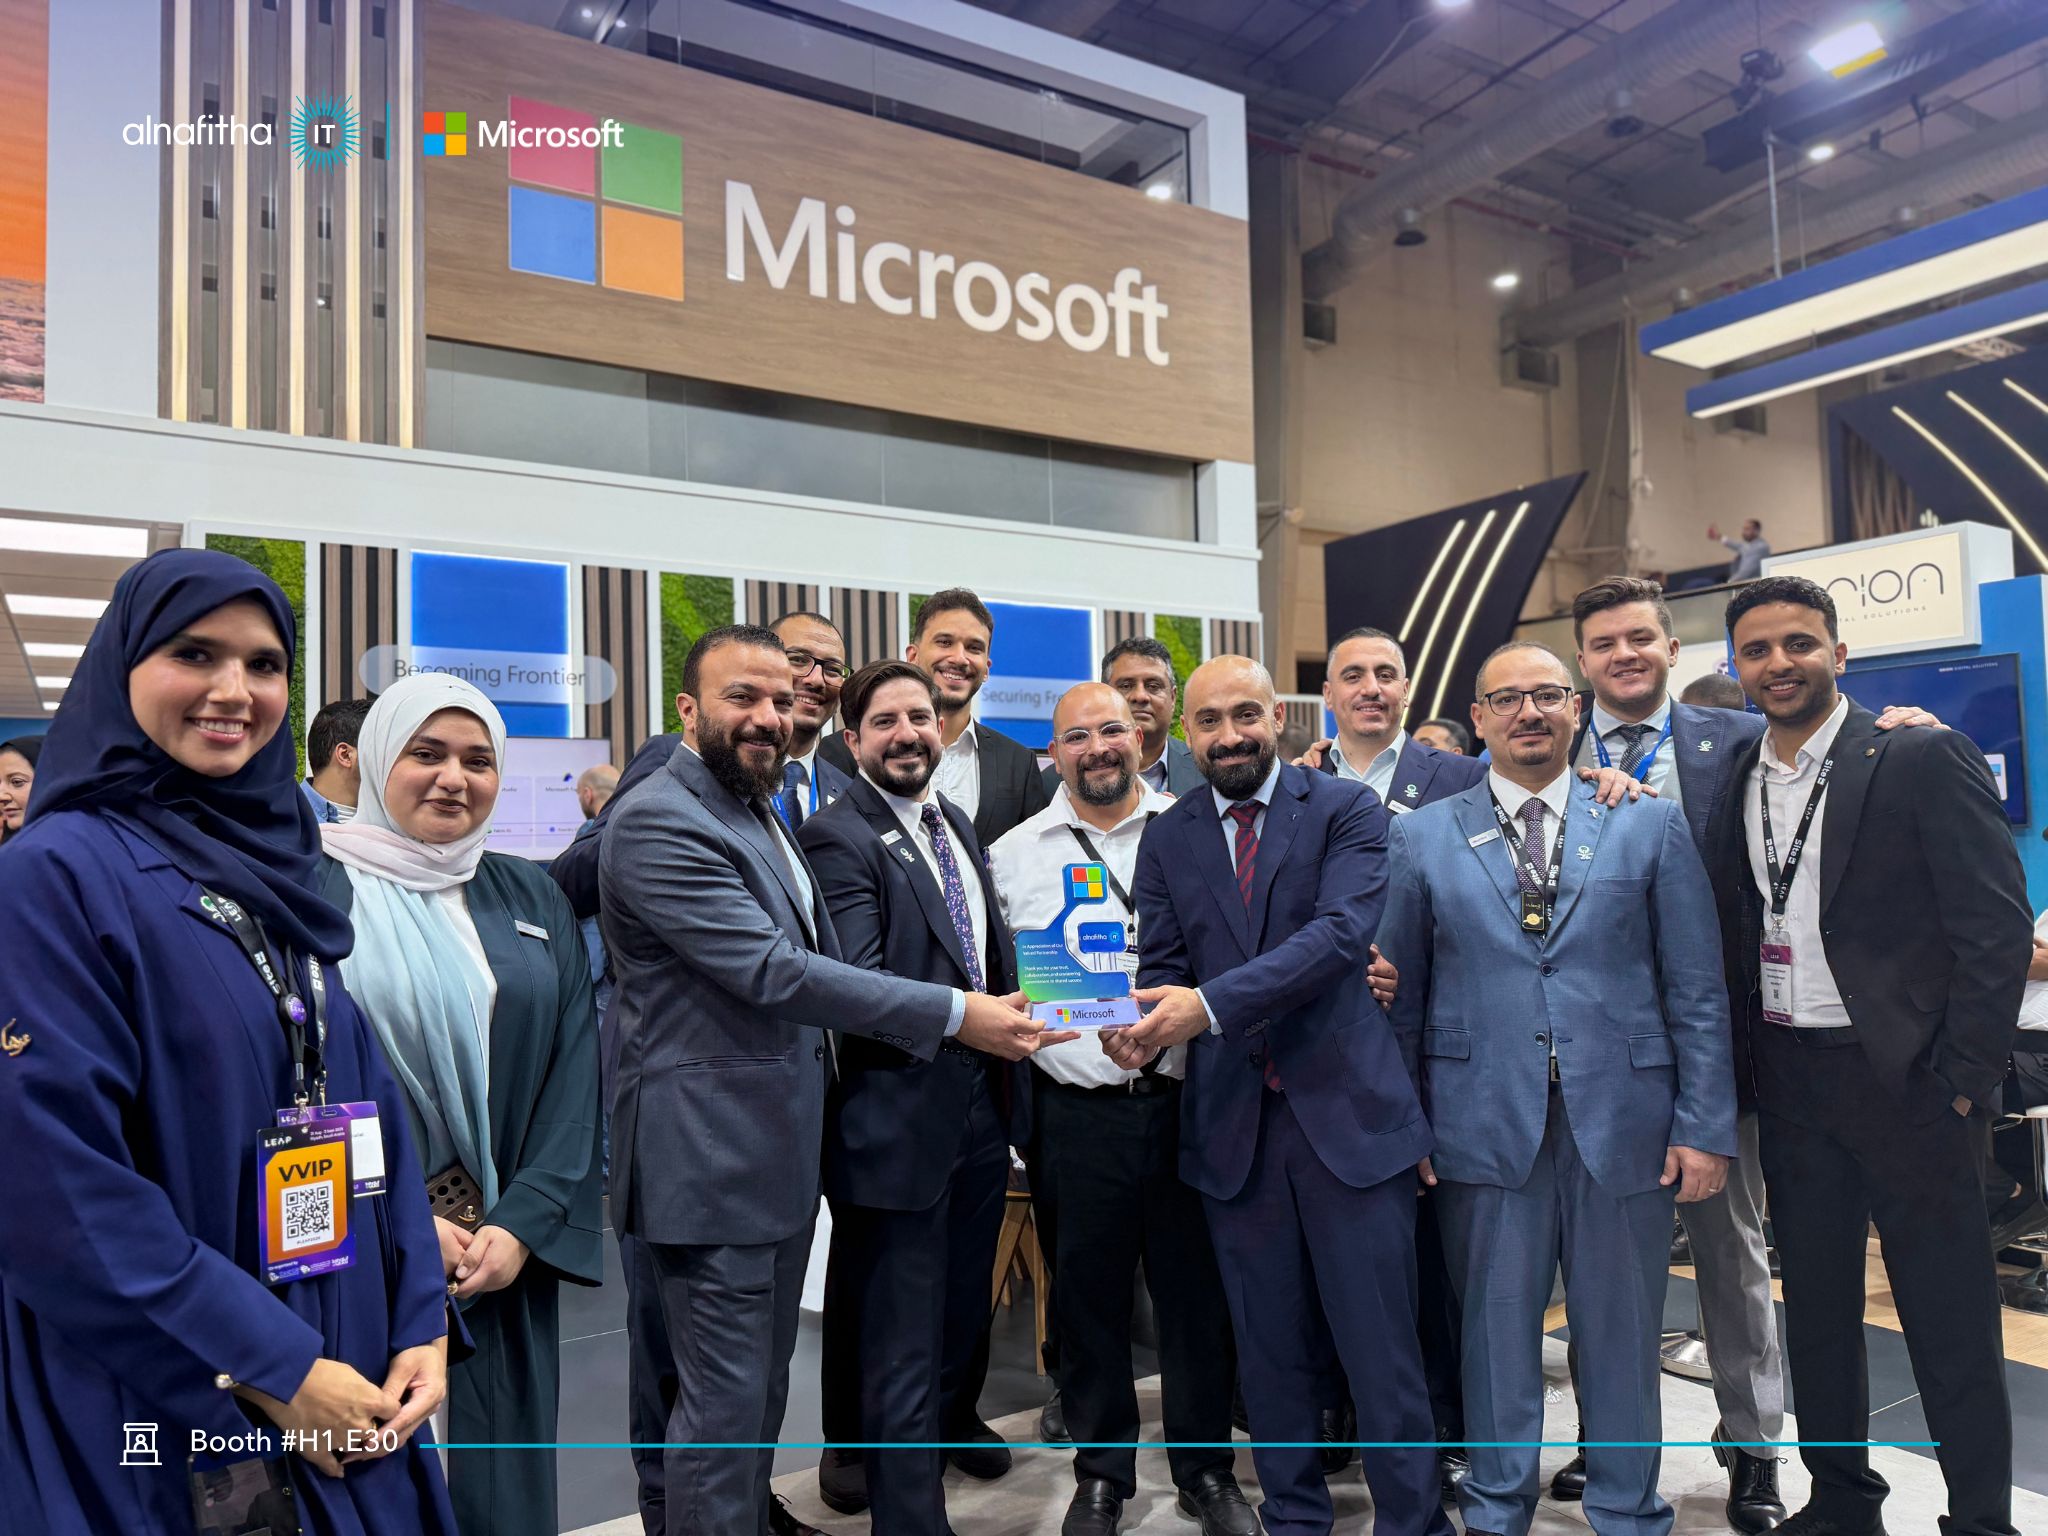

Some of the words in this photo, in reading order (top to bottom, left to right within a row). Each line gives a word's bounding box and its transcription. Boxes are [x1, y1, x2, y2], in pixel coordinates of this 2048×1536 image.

[725, 178, 1170, 366] Microsoft
[508, 665, 586, 687] Frontier
[981, 687, 1042, 708] Securing
[1072, 1008, 1115, 1019] Microsoft
[264, 1135, 292, 1148] LEAP
[278, 1158, 333, 1182] VVIP
